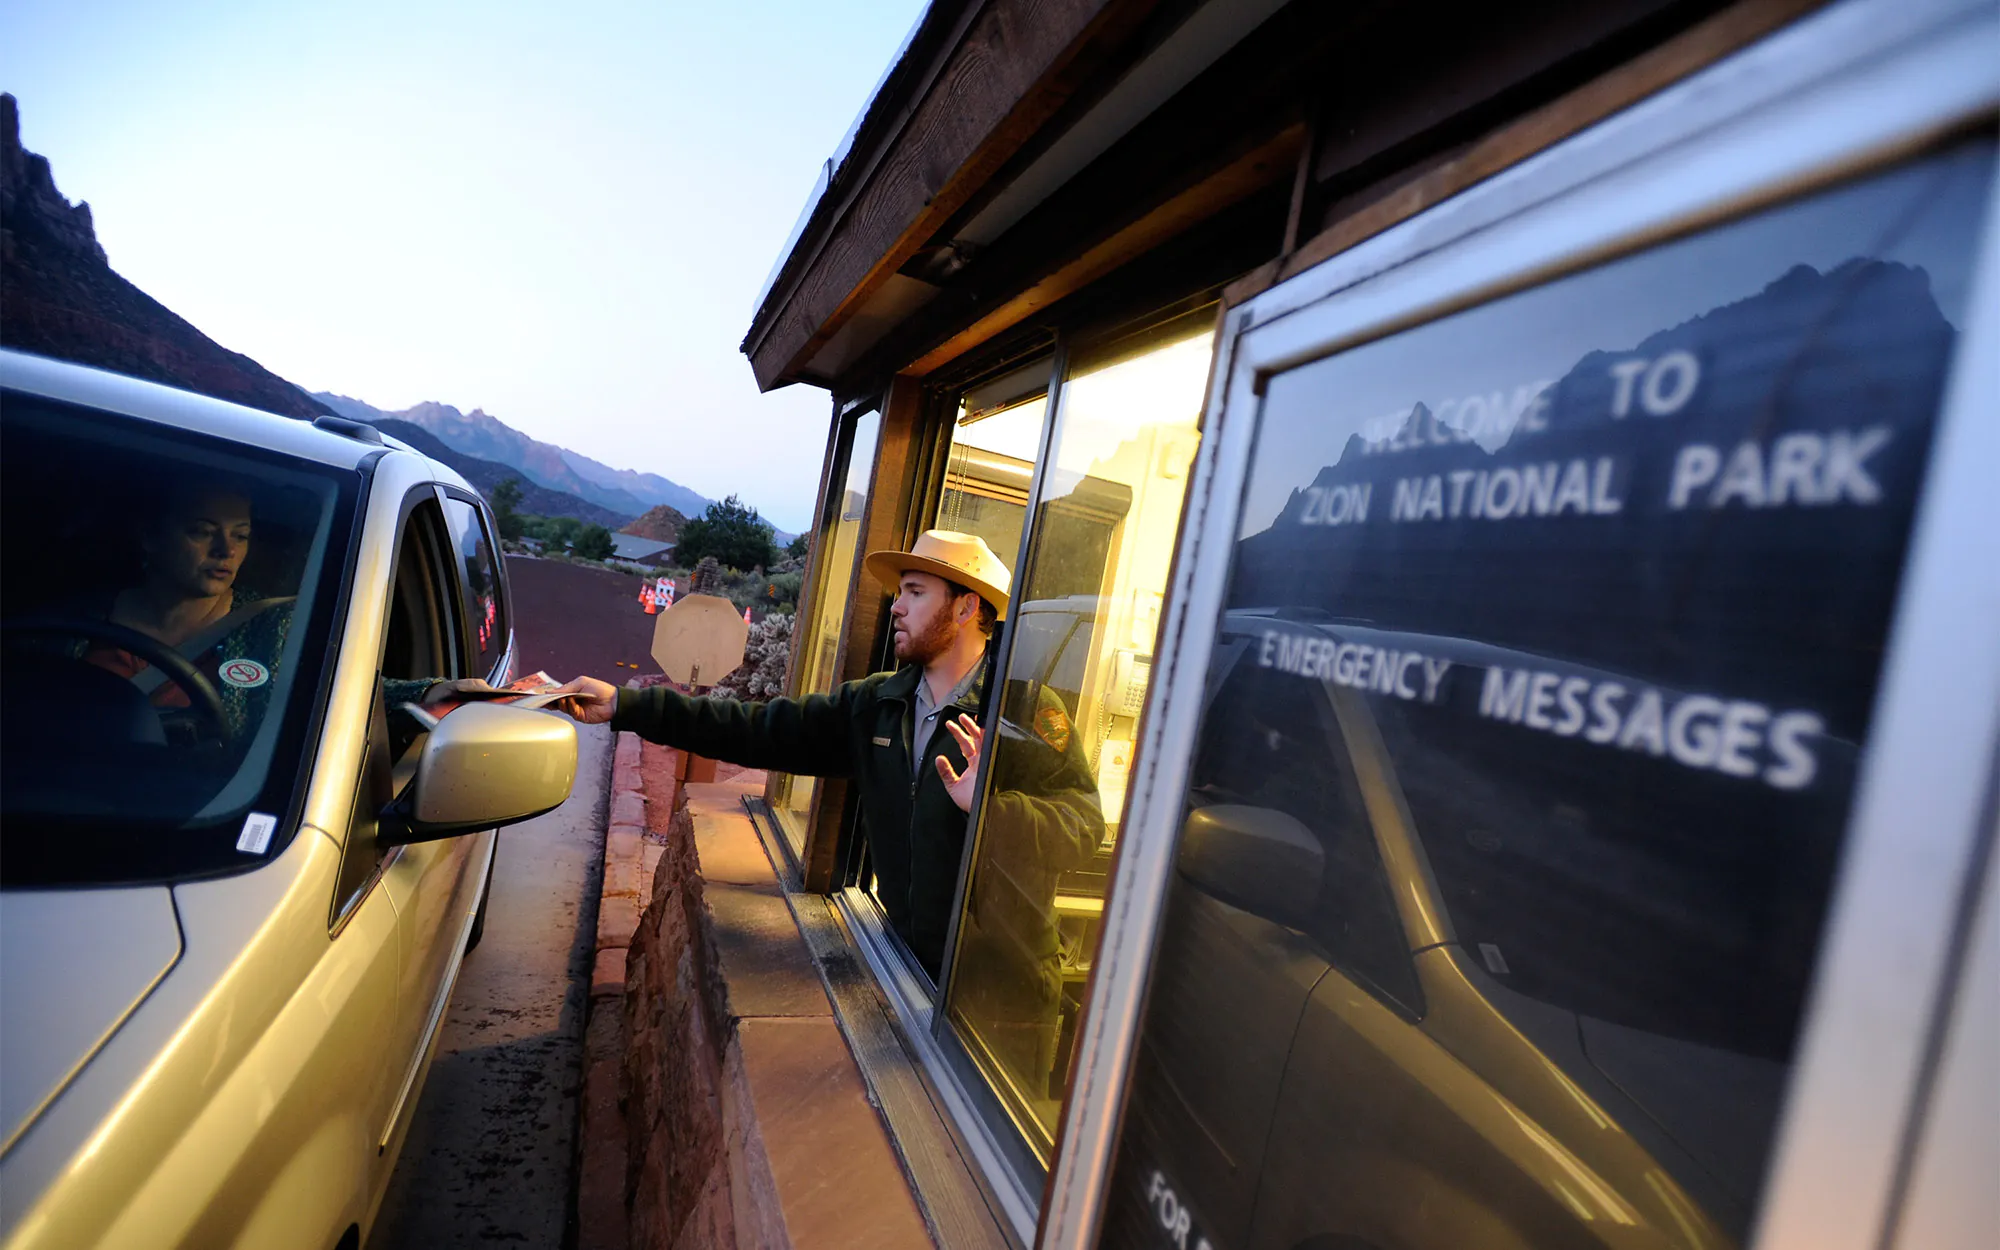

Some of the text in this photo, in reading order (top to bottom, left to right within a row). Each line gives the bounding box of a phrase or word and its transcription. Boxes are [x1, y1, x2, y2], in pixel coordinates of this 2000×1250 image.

[1363, 351, 1699, 455] WELCOME TO
[1301, 428, 1891, 525] ZION NATIONAL PARK
[1259, 631, 1824, 789] EMERGENCY MESSAGES
[1150, 1171, 1190, 1249] FOR
